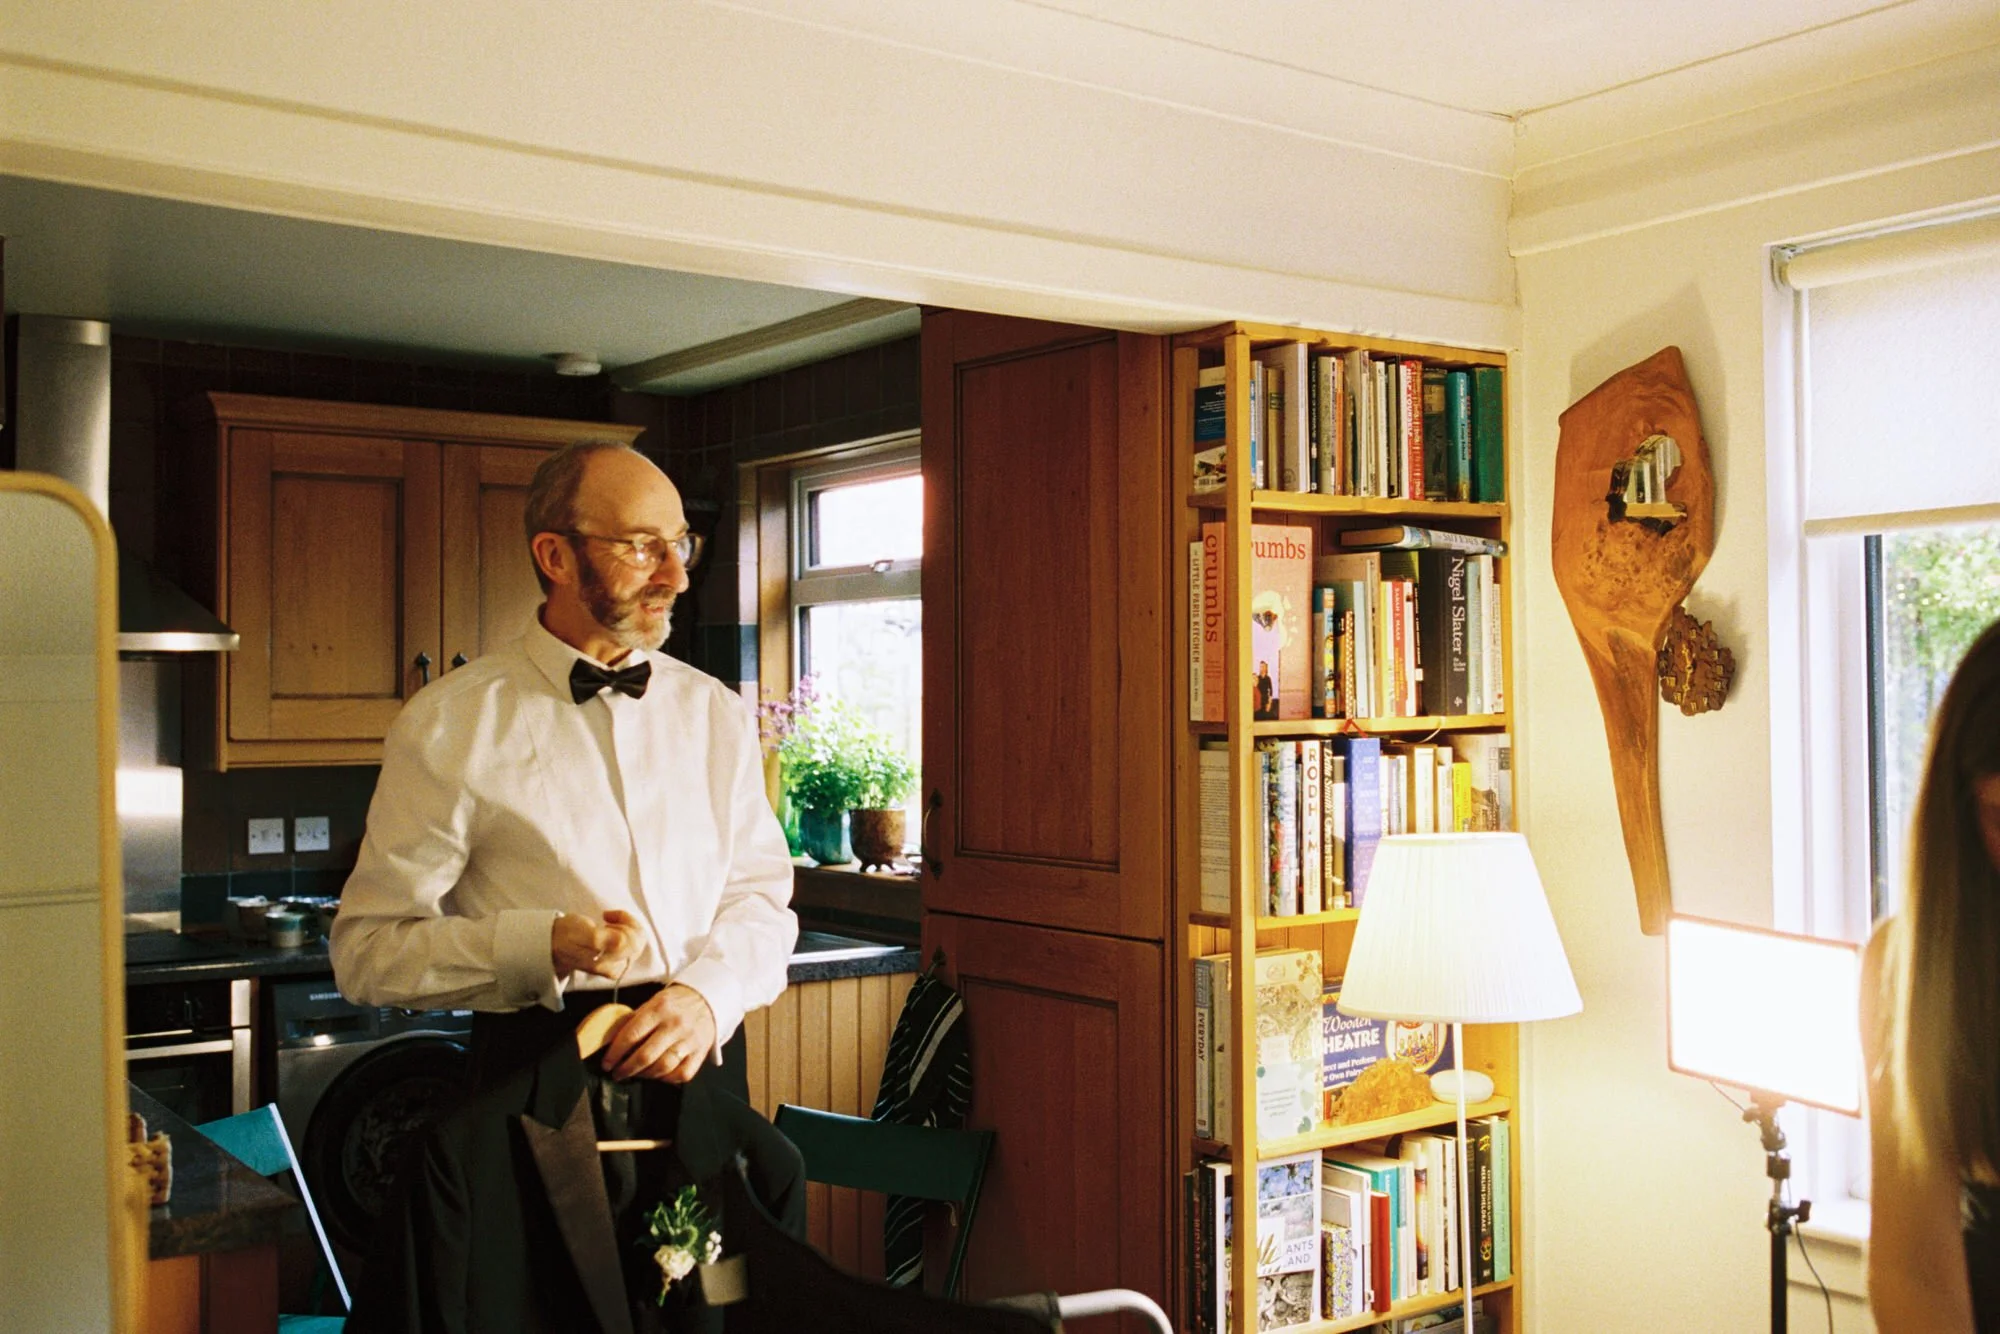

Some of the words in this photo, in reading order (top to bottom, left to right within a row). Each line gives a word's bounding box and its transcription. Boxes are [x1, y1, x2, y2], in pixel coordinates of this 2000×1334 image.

[1251, 537, 1307, 560] umbs
[1192, 558, 1200, 589] LITTLE
[1448, 557, 1465, 602] Nigel
[1205, 534, 1222, 643] crumbs
[1192, 593, 1200, 618] PARIS
[1192, 621, 1200, 663] KITCHEN
[1452, 606, 1466, 655] Slater
[309, 992, 342, 1001] SAMSUN
[1323, 1015, 1372, 1034] Wooden
[1323, 1028, 1381, 1054] HEATRE
[1287, 1239, 1314, 1253] ANTS
[1287, 1253, 1311, 1266] AND
